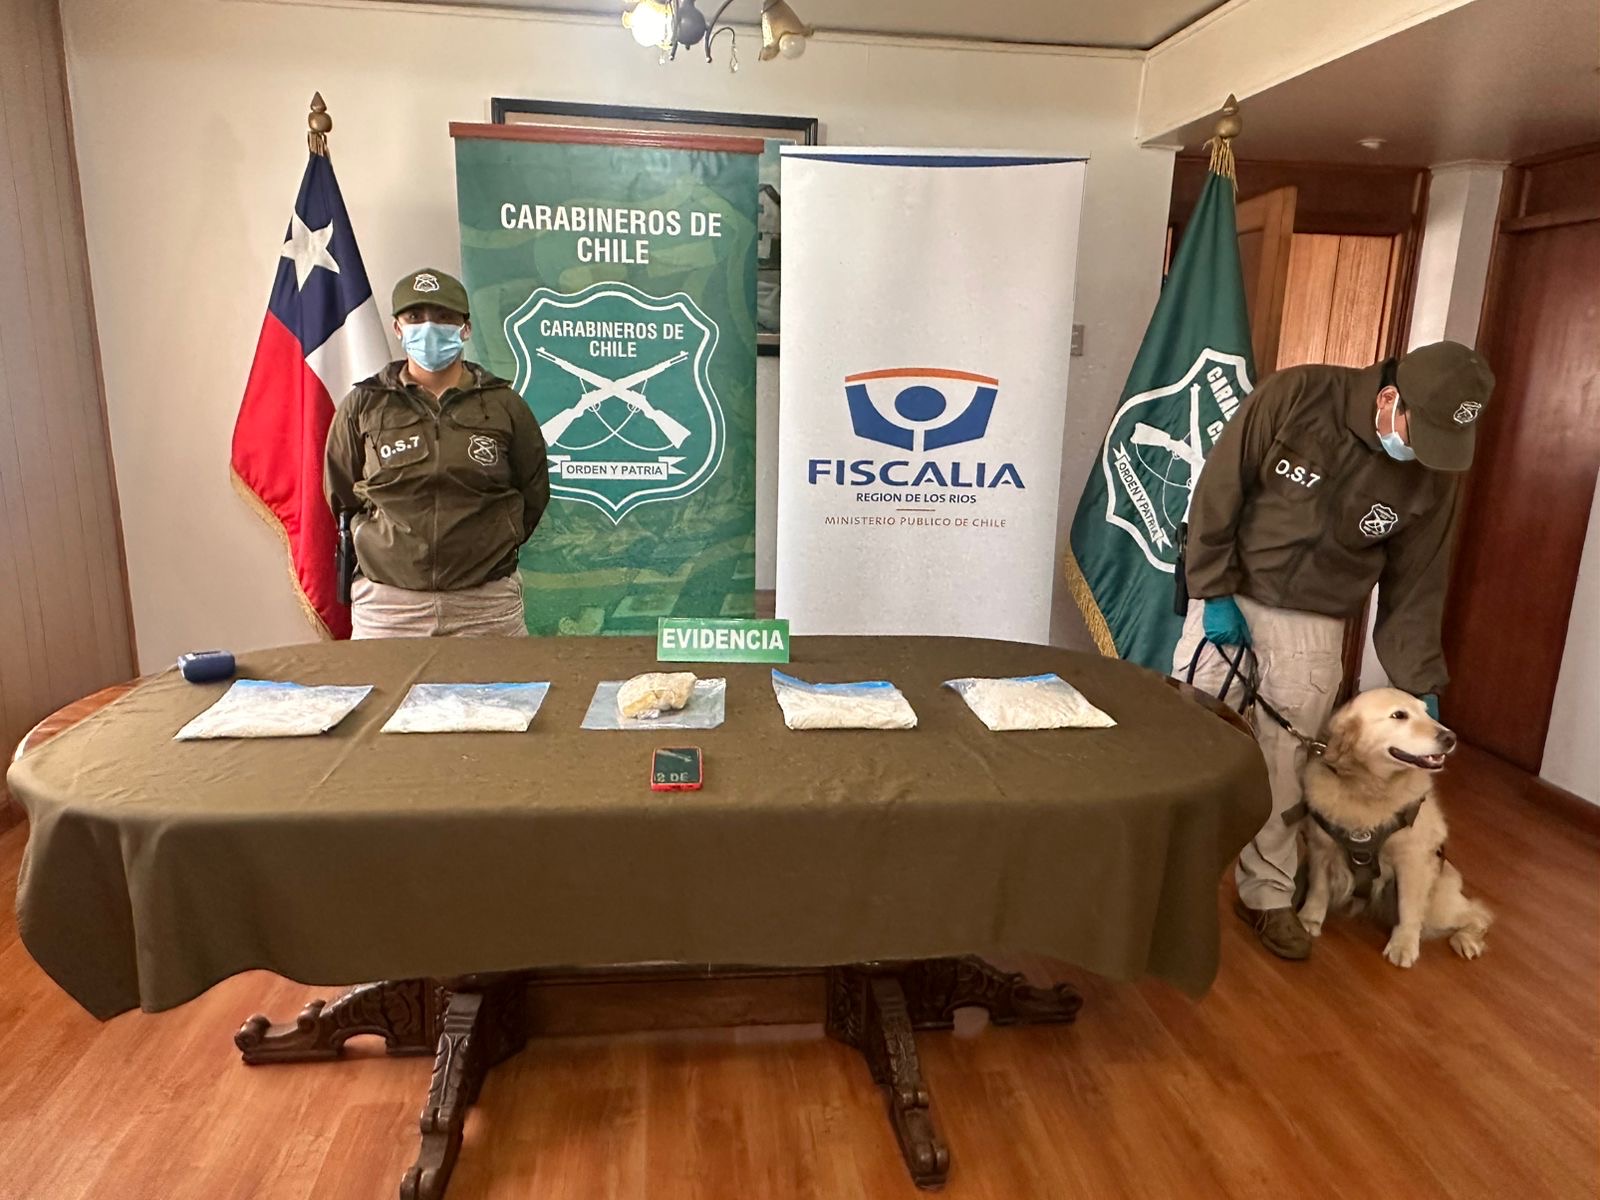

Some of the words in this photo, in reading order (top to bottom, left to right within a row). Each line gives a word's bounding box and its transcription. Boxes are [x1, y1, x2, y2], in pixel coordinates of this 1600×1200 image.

[501, 203, 681, 236] CARABINEROS
[690, 212, 722, 237] DE
[577, 237, 649, 264] CHILE
[540, 320, 657, 339] CARABINEROS
[663, 323, 684, 340] DE
[589, 340, 637, 358] CHILE
[380, 435, 420, 458] O.S.7
[566, 464, 607, 474] ORDEN
[610, 465, 619, 475] Y
[621, 465, 663, 475] PATRIA
[808, 459, 1026, 489] FISCALIA
[1275, 459, 1320, 488] O.S.7
[856, 492, 901, 503] REGION
[905, 493, 921, 503] DE
[924, 493, 946, 503] LOS
[949, 494, 977, 504] RIOS
[1119, 462, 1142, 498] ORDEN
[1133, 492, 1145, 506] Y
[1139, 500, 1159, 538] PATRIA
[825, 516, 896, 526] MINISTERIO
[900, 517, 951, 527] PUBLICO
[954, 518, 968, 527] DE
[972, 518, 1007, 528] CHILE
[662, 628, 784, 650] EVIDENCIA
